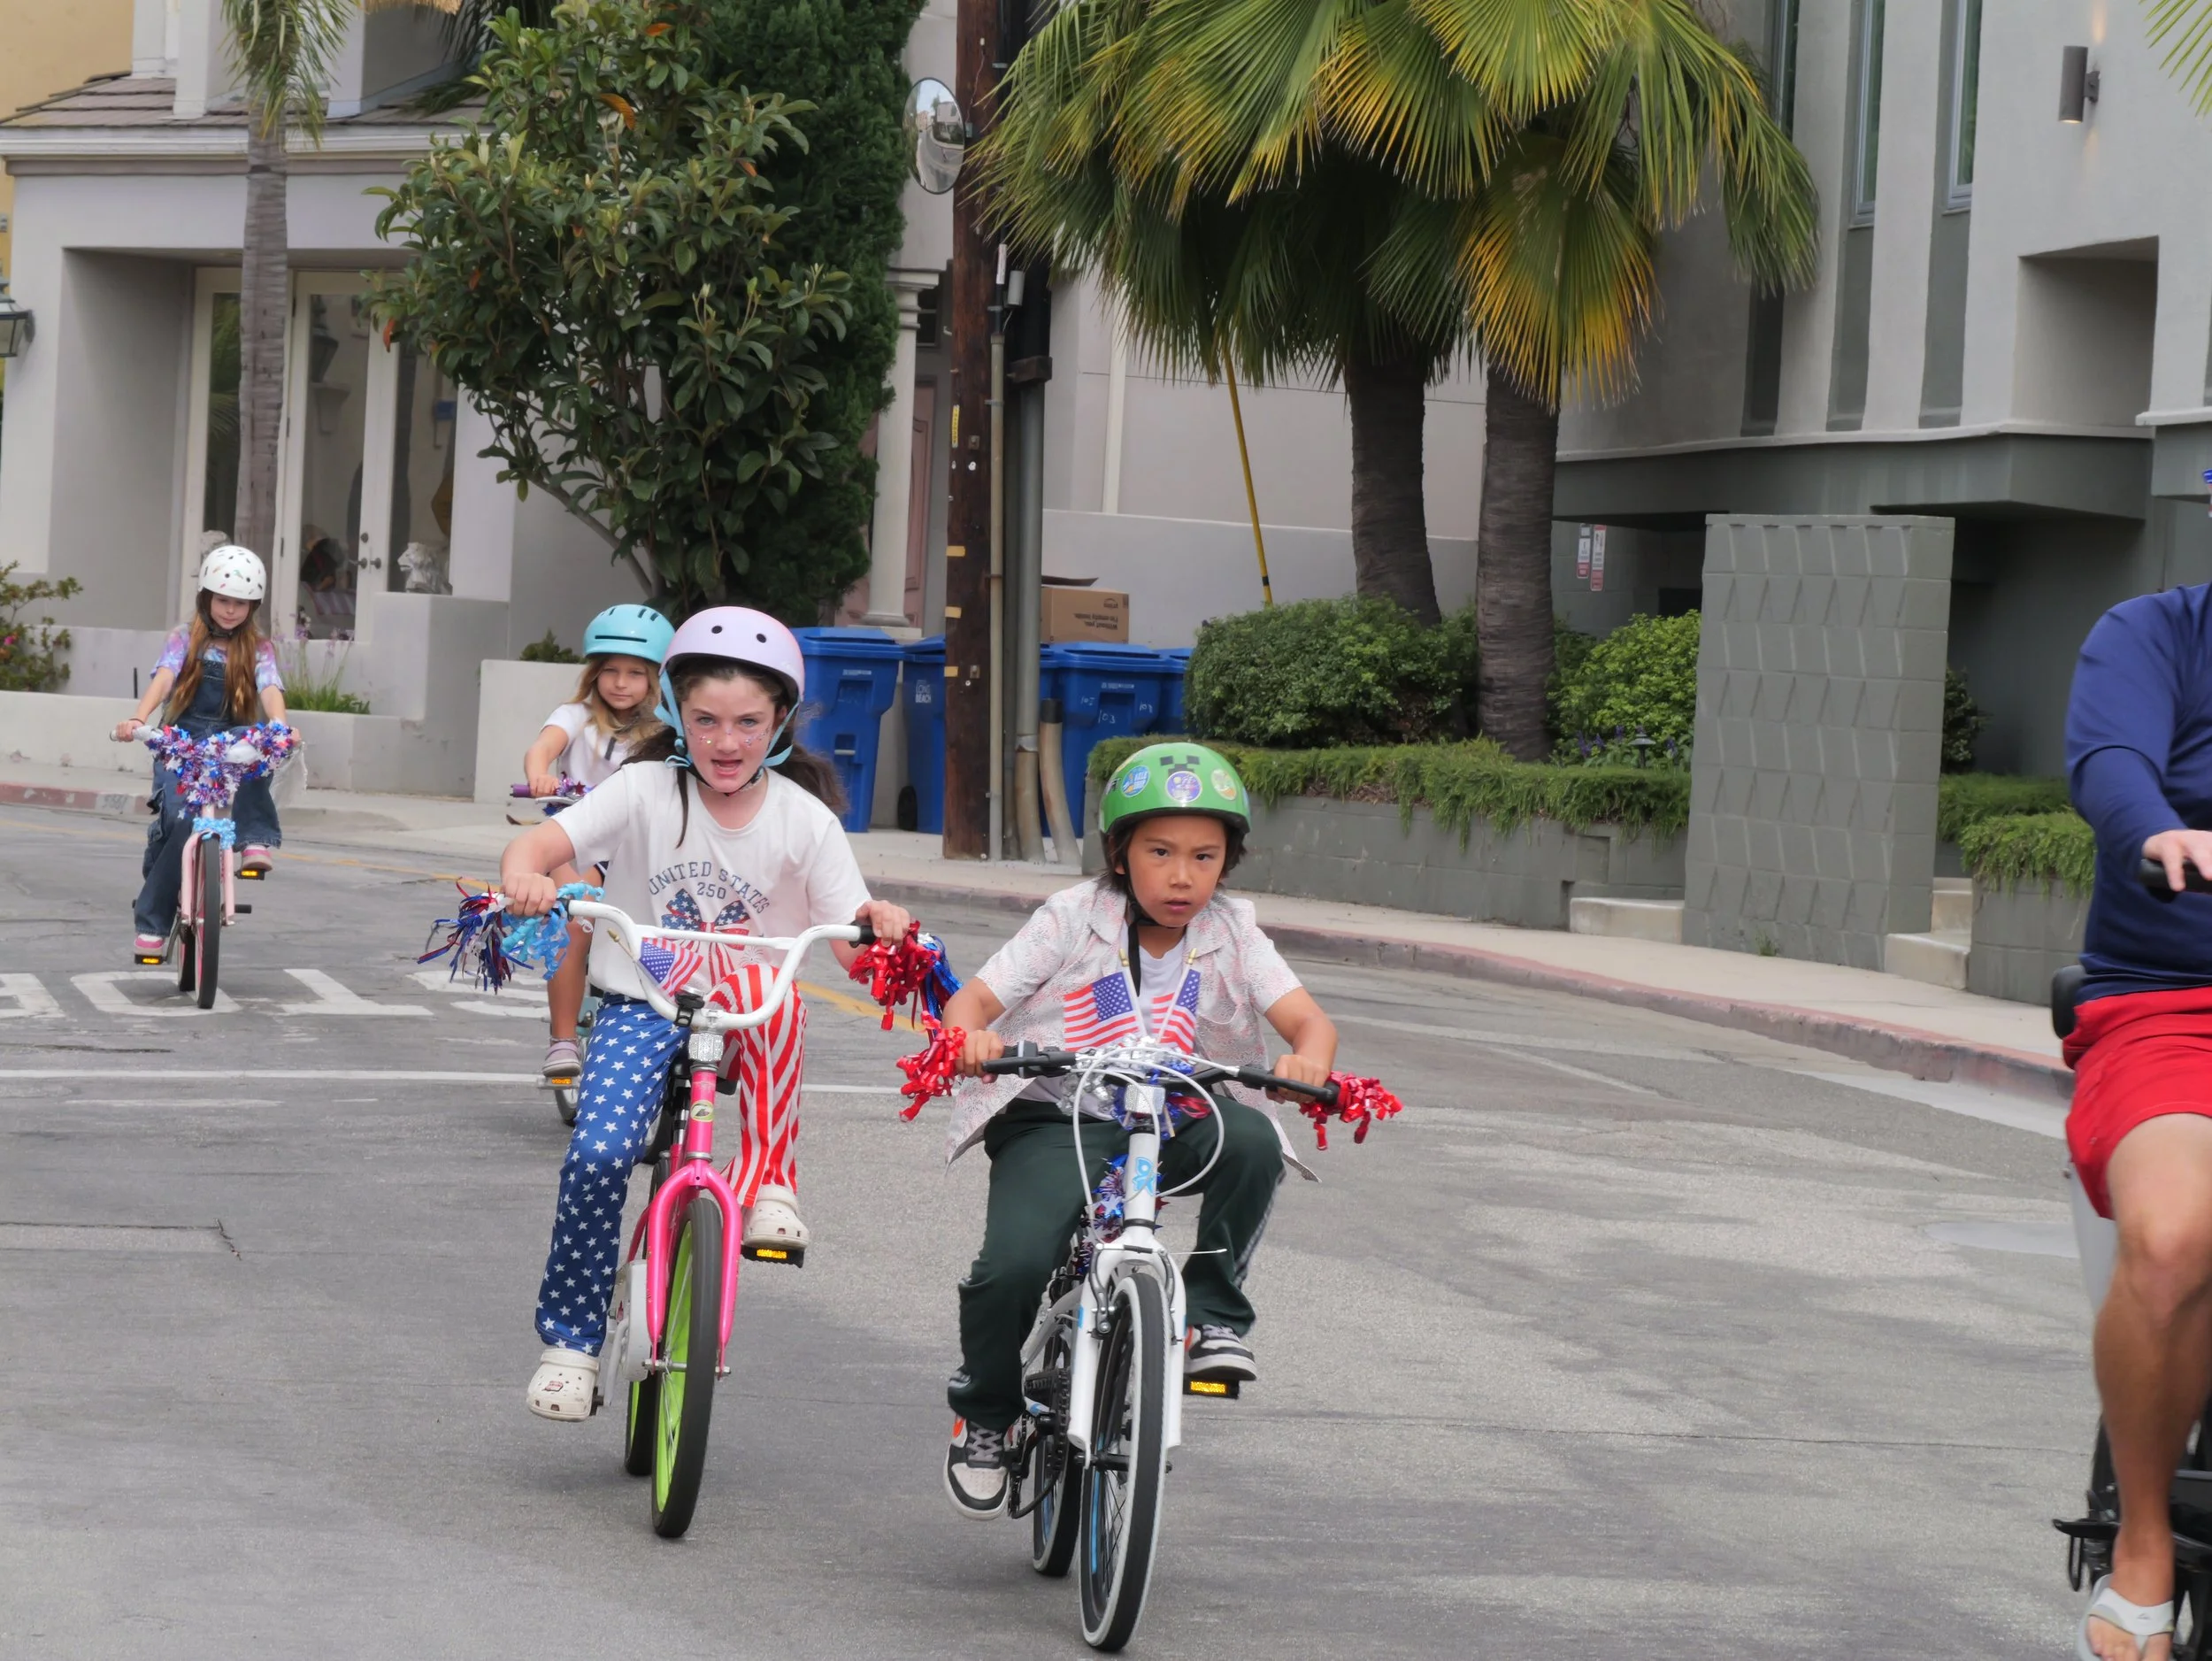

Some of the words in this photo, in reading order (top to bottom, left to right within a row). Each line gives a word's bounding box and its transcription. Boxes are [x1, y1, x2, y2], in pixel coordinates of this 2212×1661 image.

[1098, 709, 1116, 724] 103
[649, 861, 712, 896] UNITED
[718, 868, 770, 914] STATES
[696, 881, 726, 900] 250
